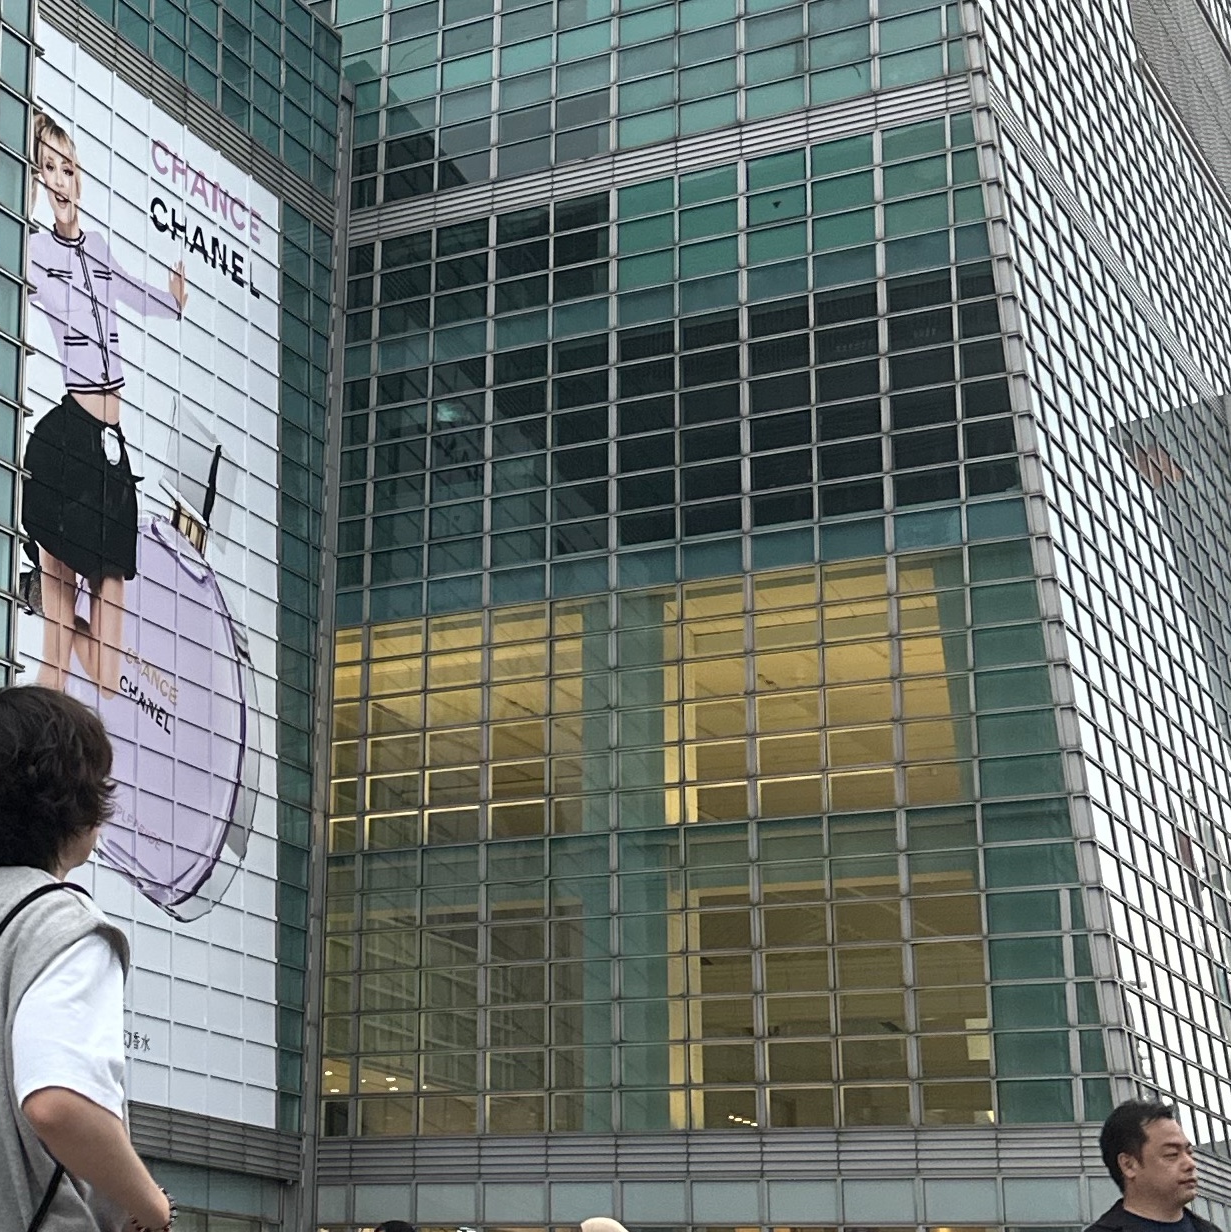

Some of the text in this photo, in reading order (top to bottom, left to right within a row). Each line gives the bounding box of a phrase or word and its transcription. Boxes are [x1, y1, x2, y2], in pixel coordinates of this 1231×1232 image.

[151, 139, 262, 245] CHANCE
[150, 196, 260, 299] CHANEL
[119, 675, 171, 735] CHANEL
[125, 647, 178, 706] CHANCE
